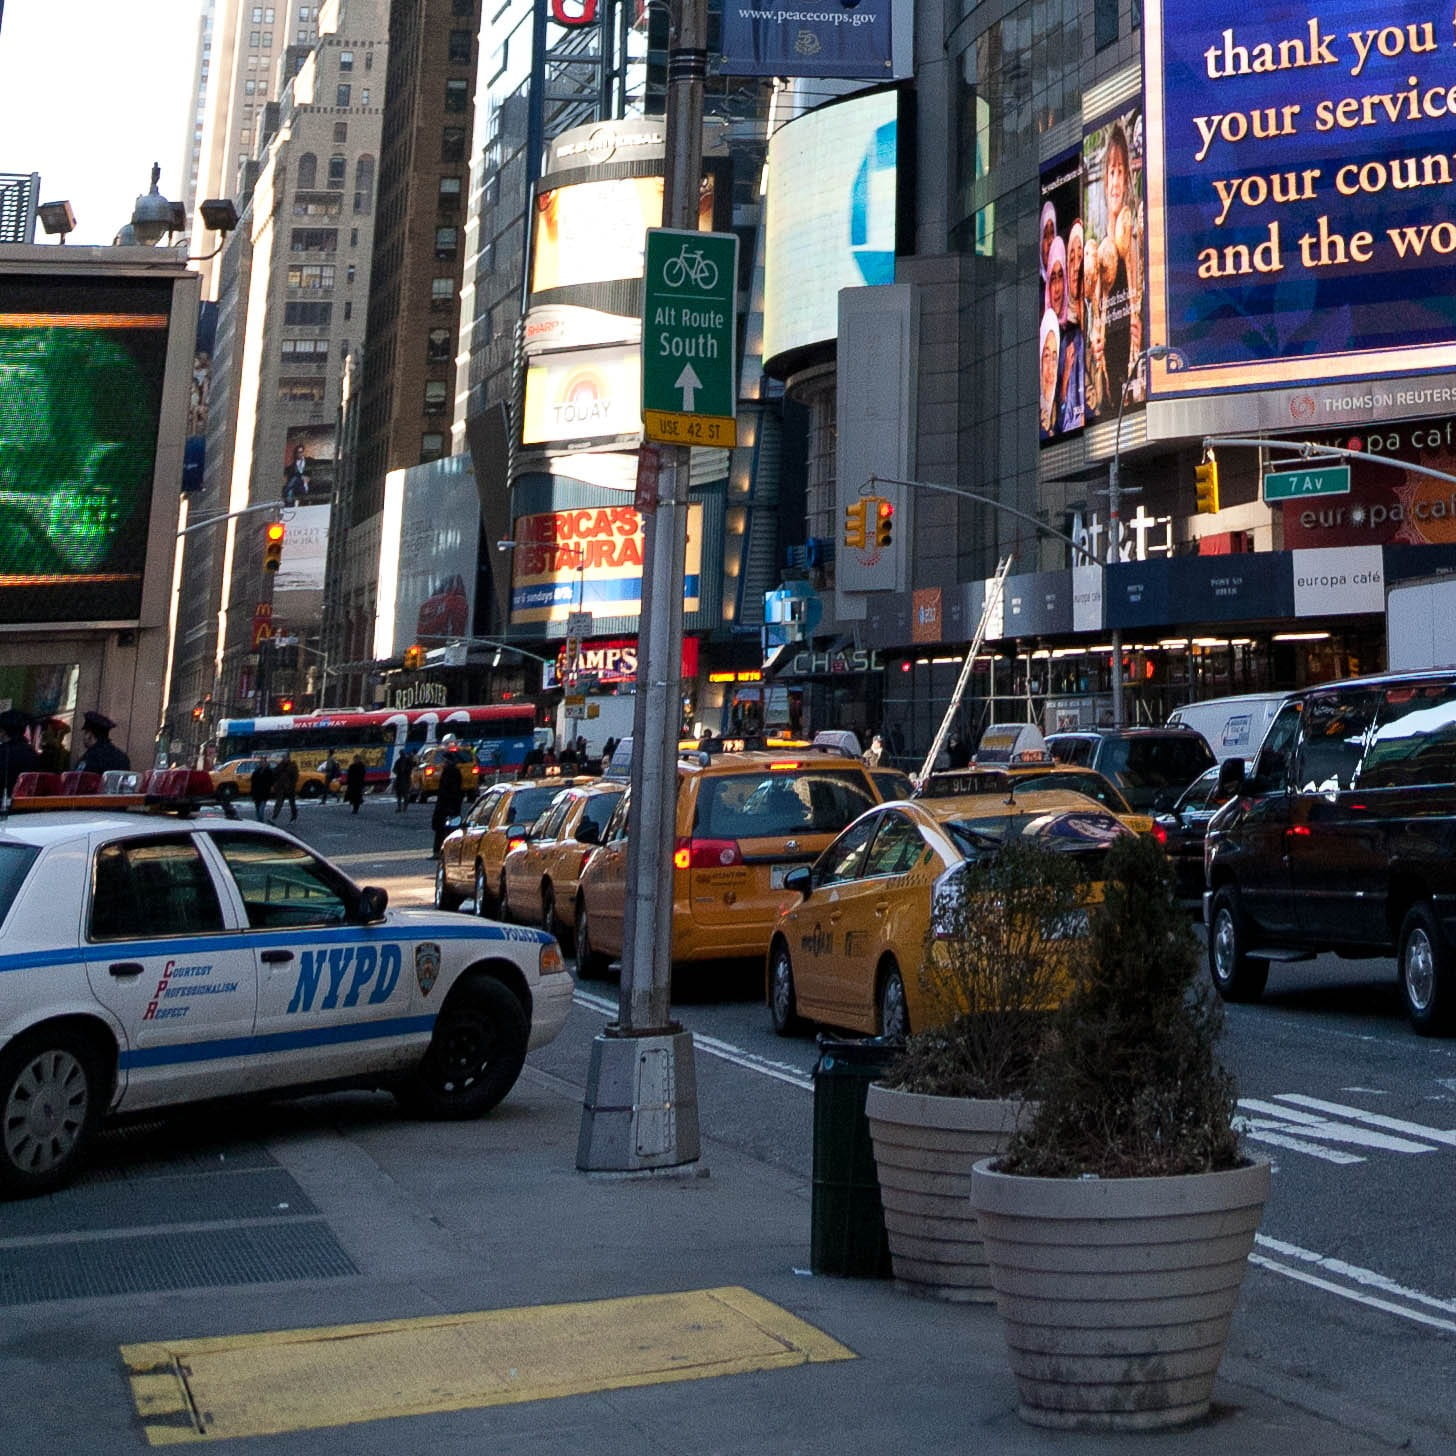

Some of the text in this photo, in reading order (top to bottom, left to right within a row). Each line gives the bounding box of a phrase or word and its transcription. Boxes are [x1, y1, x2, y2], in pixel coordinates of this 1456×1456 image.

[739, 9, 877, 27] www.peacecorps.gov
[1204, 18, 1340, 80] thank
[1347, 24, 1438, 78] you
[1193, 106, 1301, 160] your
[1213, 173, 1322, 225] your
[1197, 220, 1284, 278] and
[1298, 216, 1374, 270] the
[655, 307, 724, 330] Alt Route
[660, 332, 719, 360] South
[554, 401, 611, 423] TODAY
[1323, 391, 1393, 412] THOMSON
[659, 419, 721, 441] USE 42 ST
[1289, 475, 1324, 491] 7 Av
[1297, 570, 1381, 589] europa café
[396, 680, 447, 710] RED LOBSTER
[503, 926, 539, 944] POLICE
[163, 960, 214, 978] COURTESY
[287, 944, 402, 1014] NYPD
[154, 979, 239, 1000] PROFESSIONALISM
[143, 1001, 190, 1021] RESPECT
